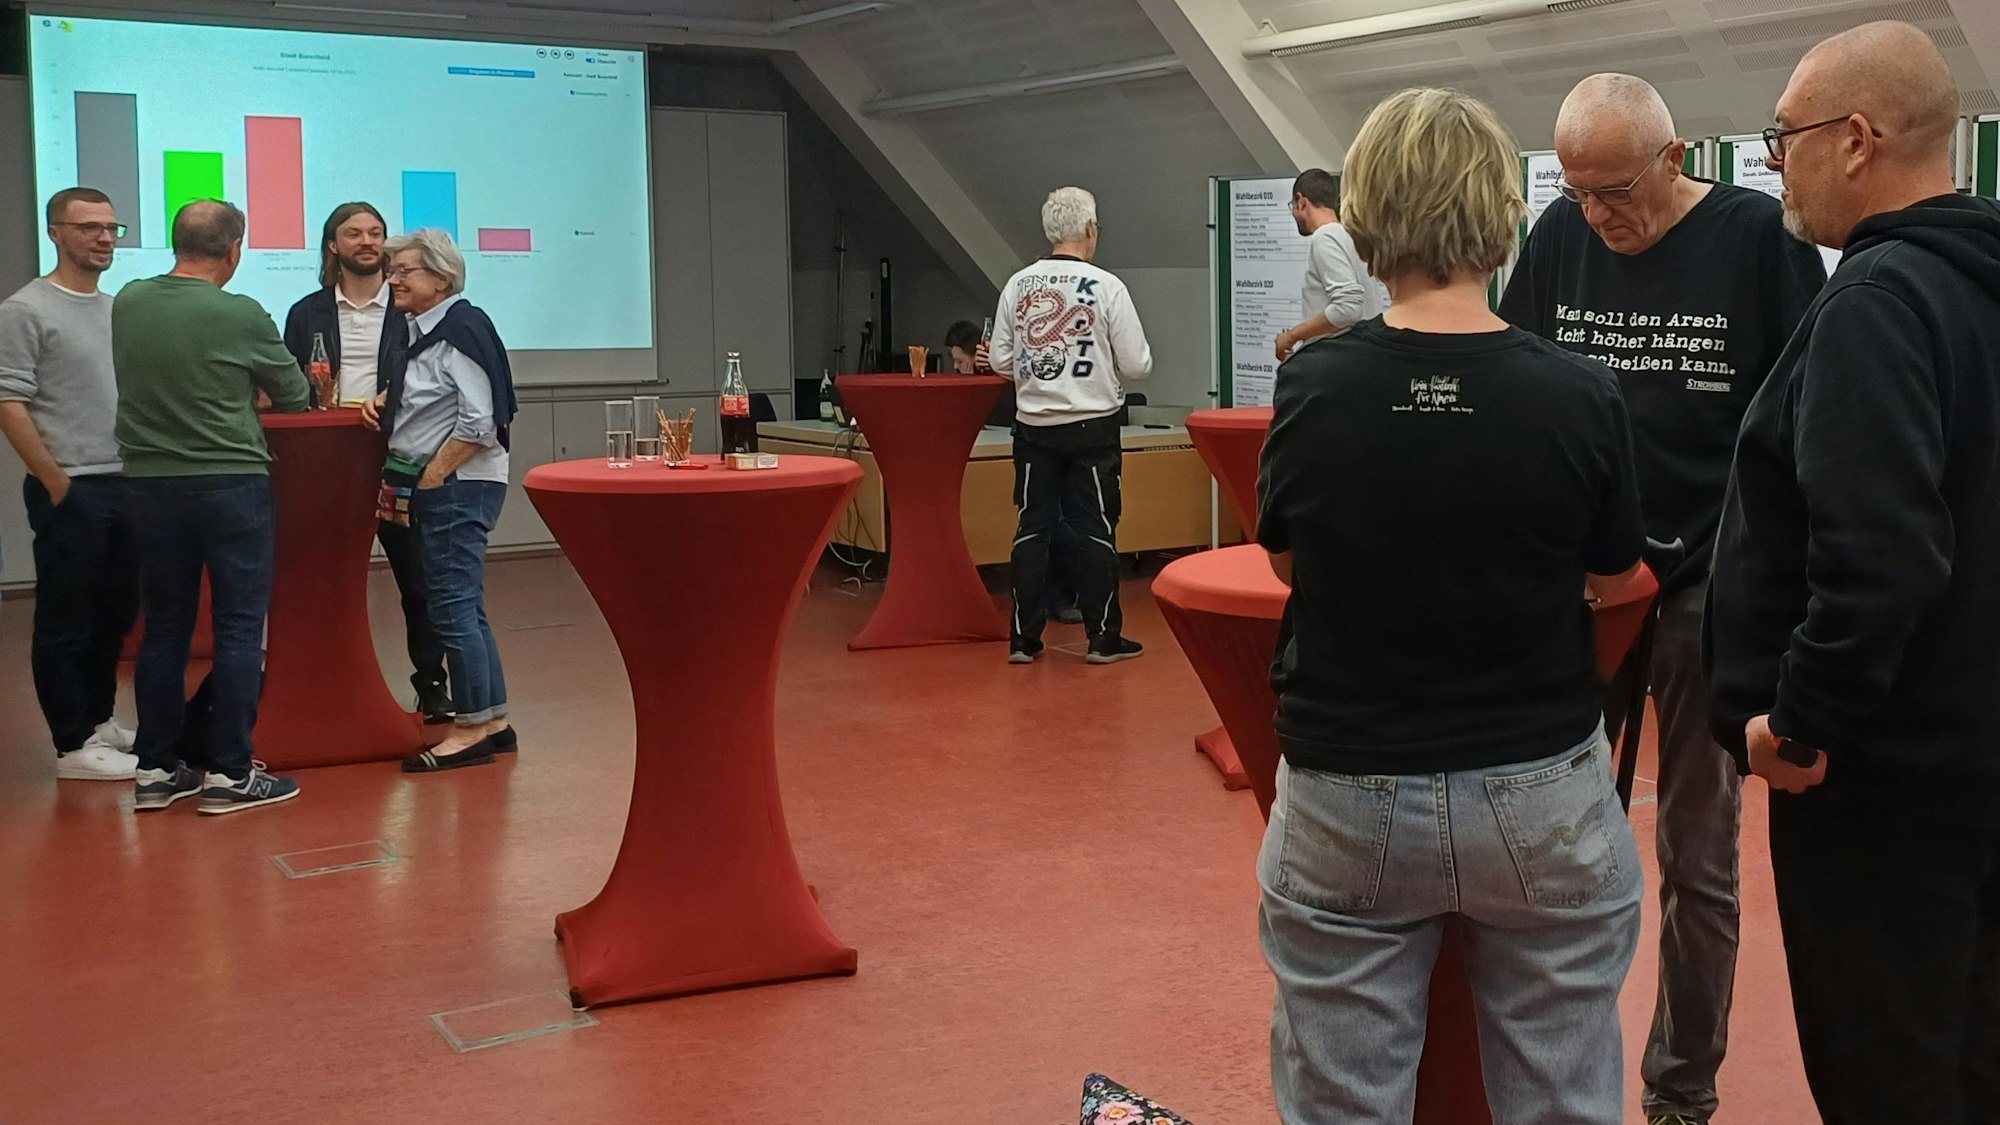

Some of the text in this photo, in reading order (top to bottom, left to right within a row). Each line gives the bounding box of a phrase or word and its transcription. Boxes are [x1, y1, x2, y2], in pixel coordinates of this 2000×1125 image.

[1235, 191, 1263, 201] Wahlbezirk
[1236, 280, 1263, 289] Wahlbezirk
[1555, 304, 1728, 330] Man soll den Arsch
[1555, 326, 1726, 352] icht höher hängen
[1236, 363, 1263, 372] Wahlbezirk
[1679, 356, 1737, 375] kann.
